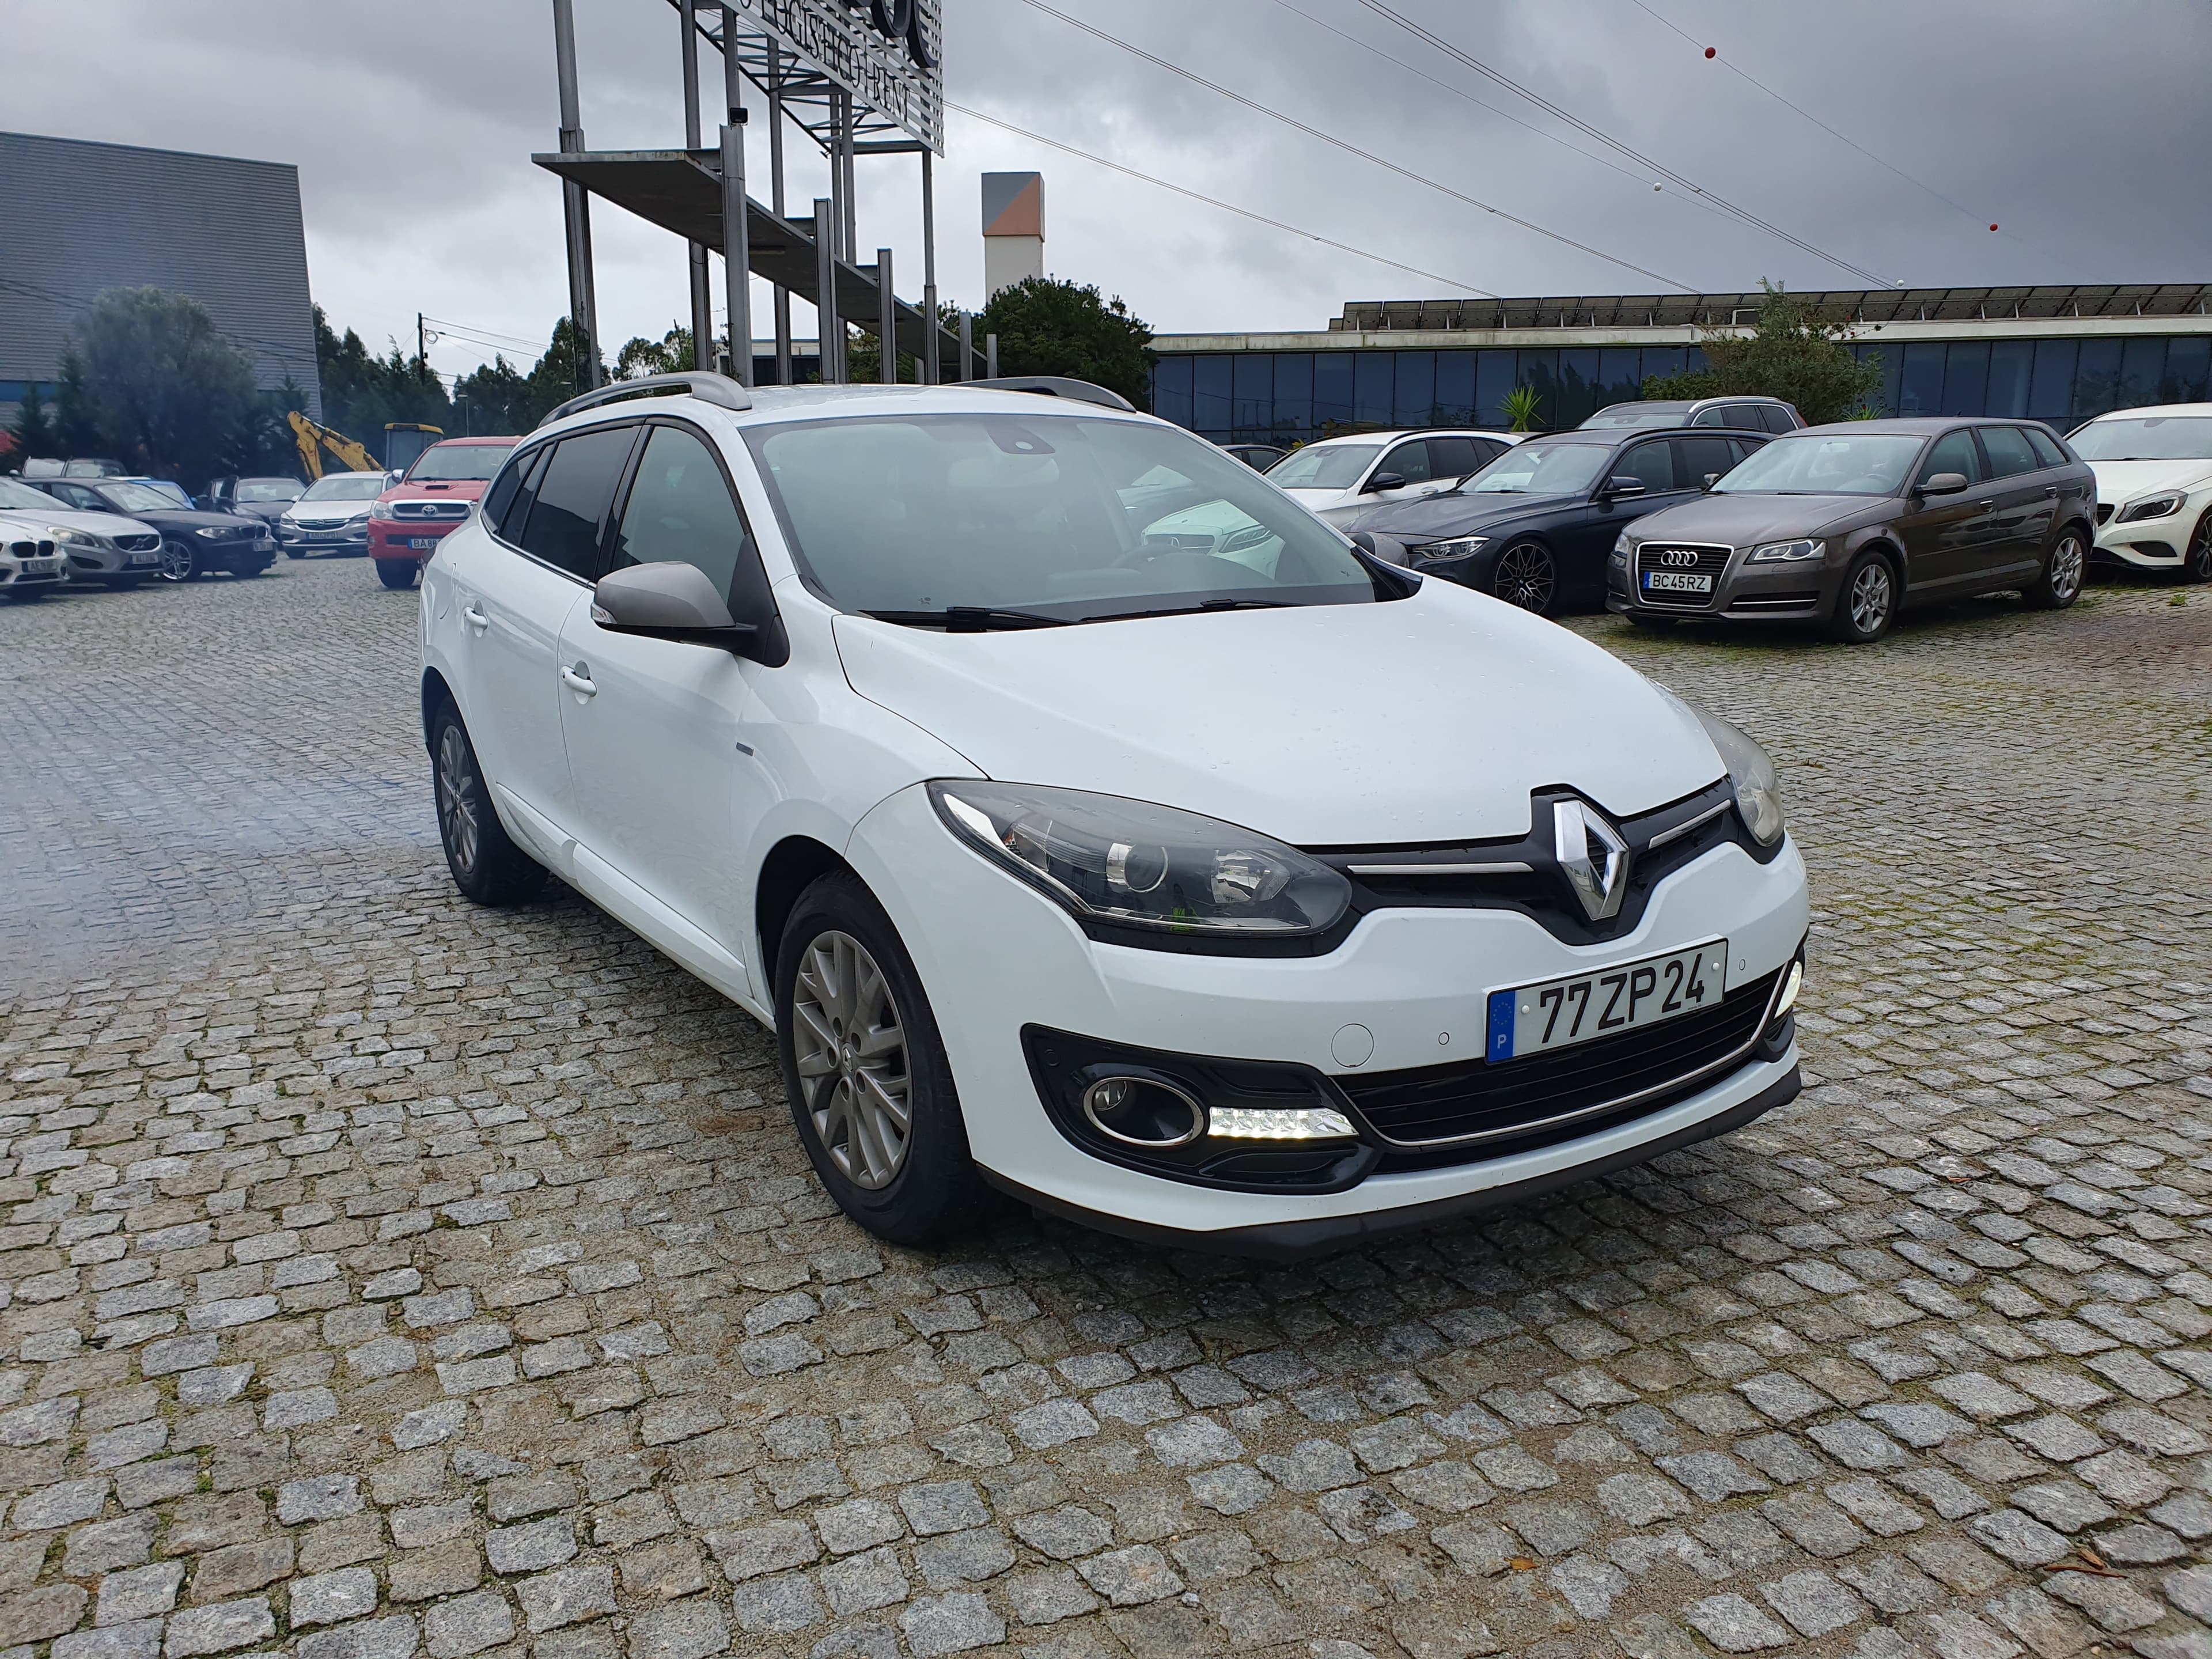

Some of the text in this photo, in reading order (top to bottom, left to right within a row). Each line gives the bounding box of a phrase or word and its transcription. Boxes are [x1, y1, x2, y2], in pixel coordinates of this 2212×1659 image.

[873, 61, 910, 123] RENT
[1653, 574, 1706, 590] BC45RZ
[1497, 953, 1705, 1049] P 77ZP24
